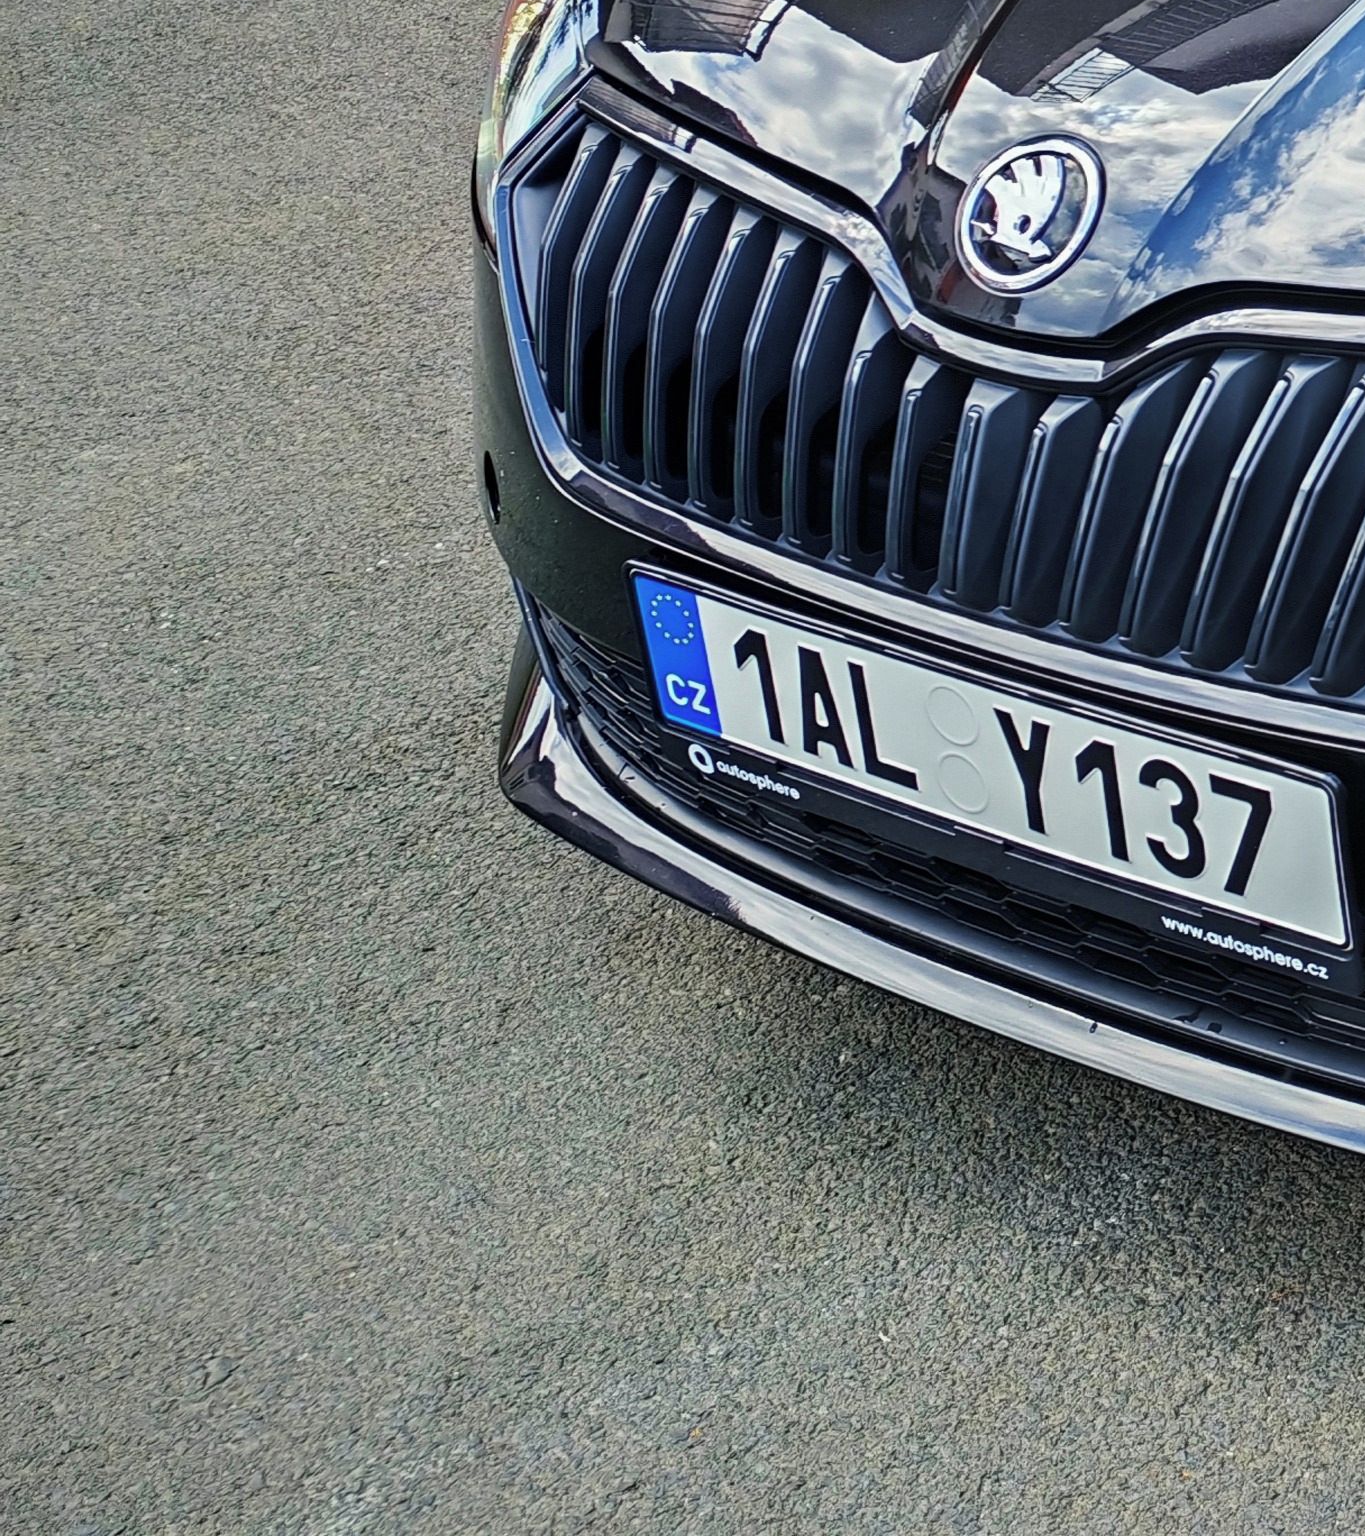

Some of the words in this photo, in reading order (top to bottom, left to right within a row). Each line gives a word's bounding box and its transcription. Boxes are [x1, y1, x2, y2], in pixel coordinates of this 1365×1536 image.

[665, 673, 711, 714] CZ
[716, 760, 800, 800] autosphere
[734, 628, 919, 791] 1AL
[993, 706, 1272, 896] Y137
[1161, 915, 1329, 980] www.autosphere.cz
